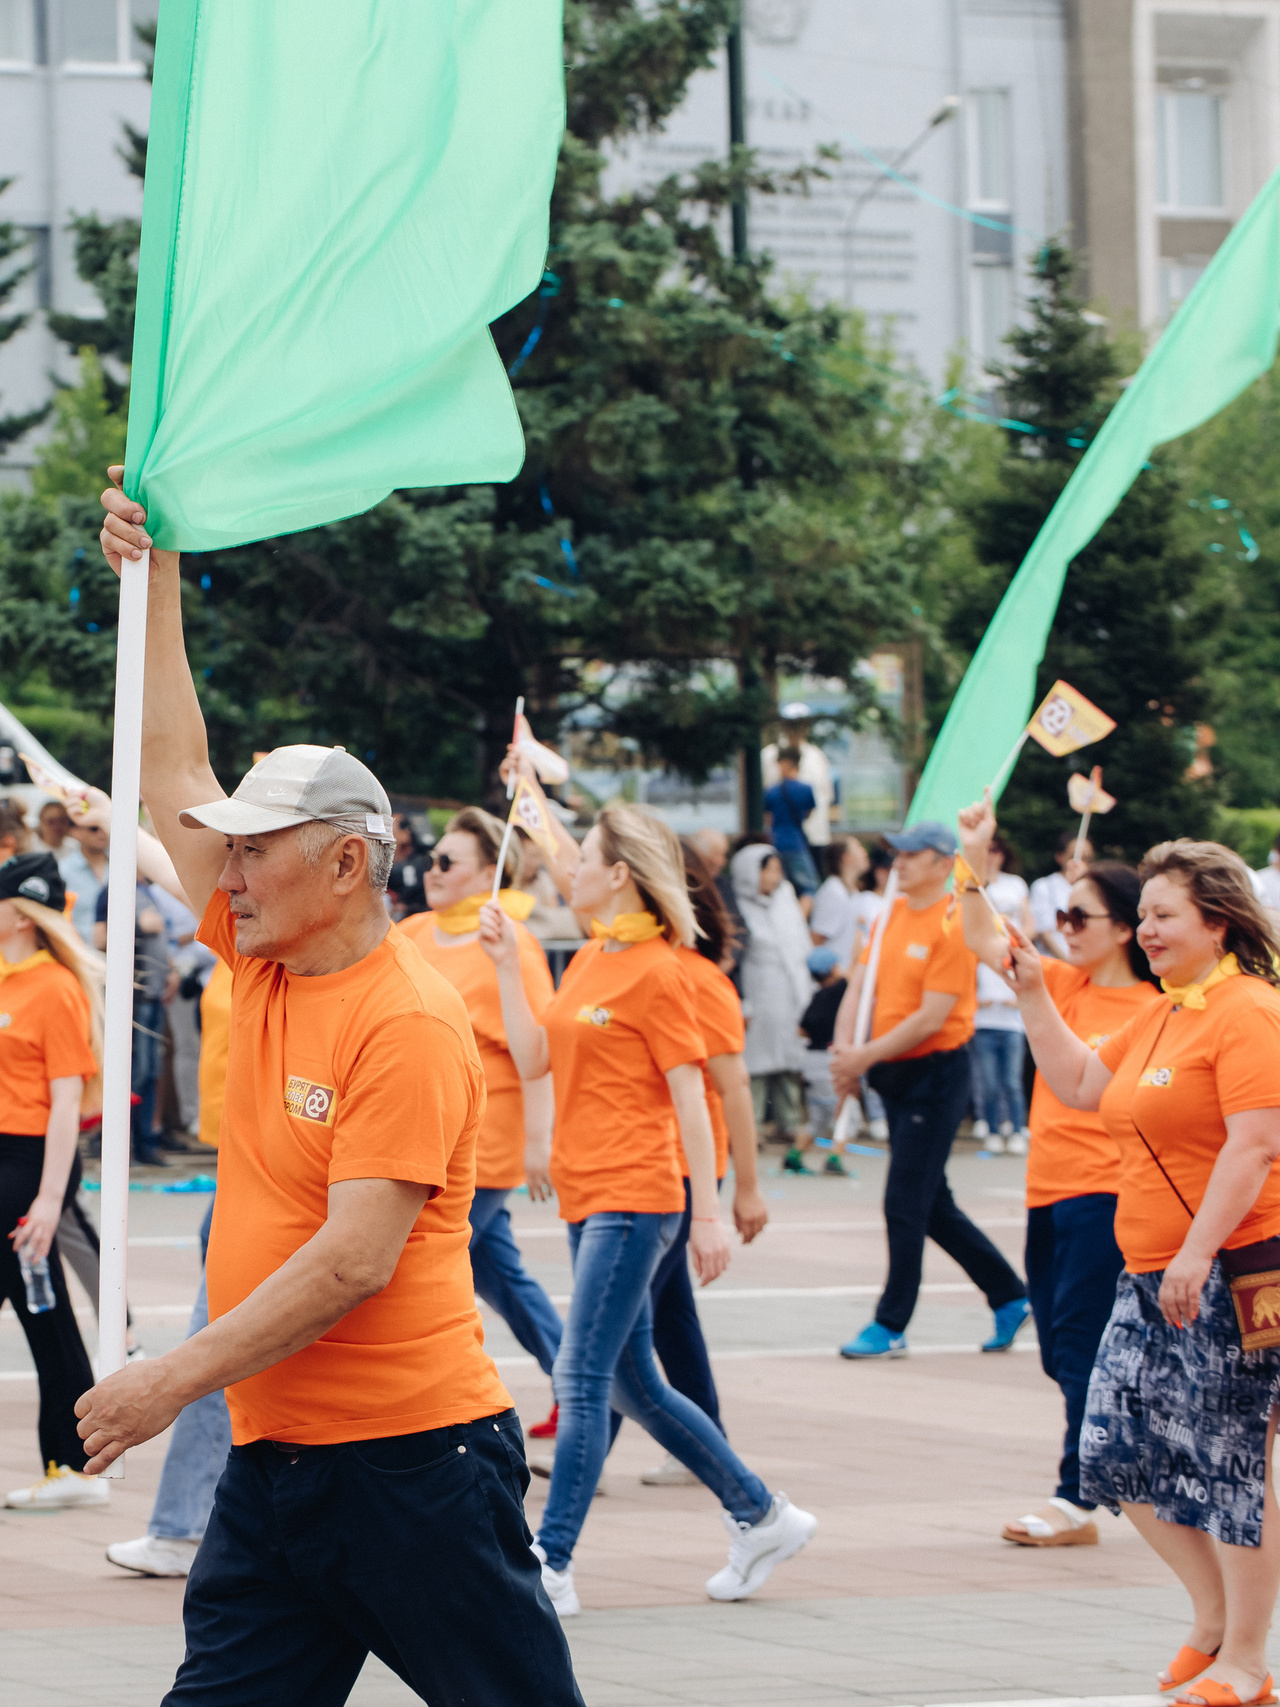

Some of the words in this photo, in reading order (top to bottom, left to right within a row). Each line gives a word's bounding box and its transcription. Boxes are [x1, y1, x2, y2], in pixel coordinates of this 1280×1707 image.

[288, 1079, 310, 1092] БУРЯТ
[285, 1090, 305, 1104] ХЛЕБ
[1175, 1474, 1207, 1504] No
